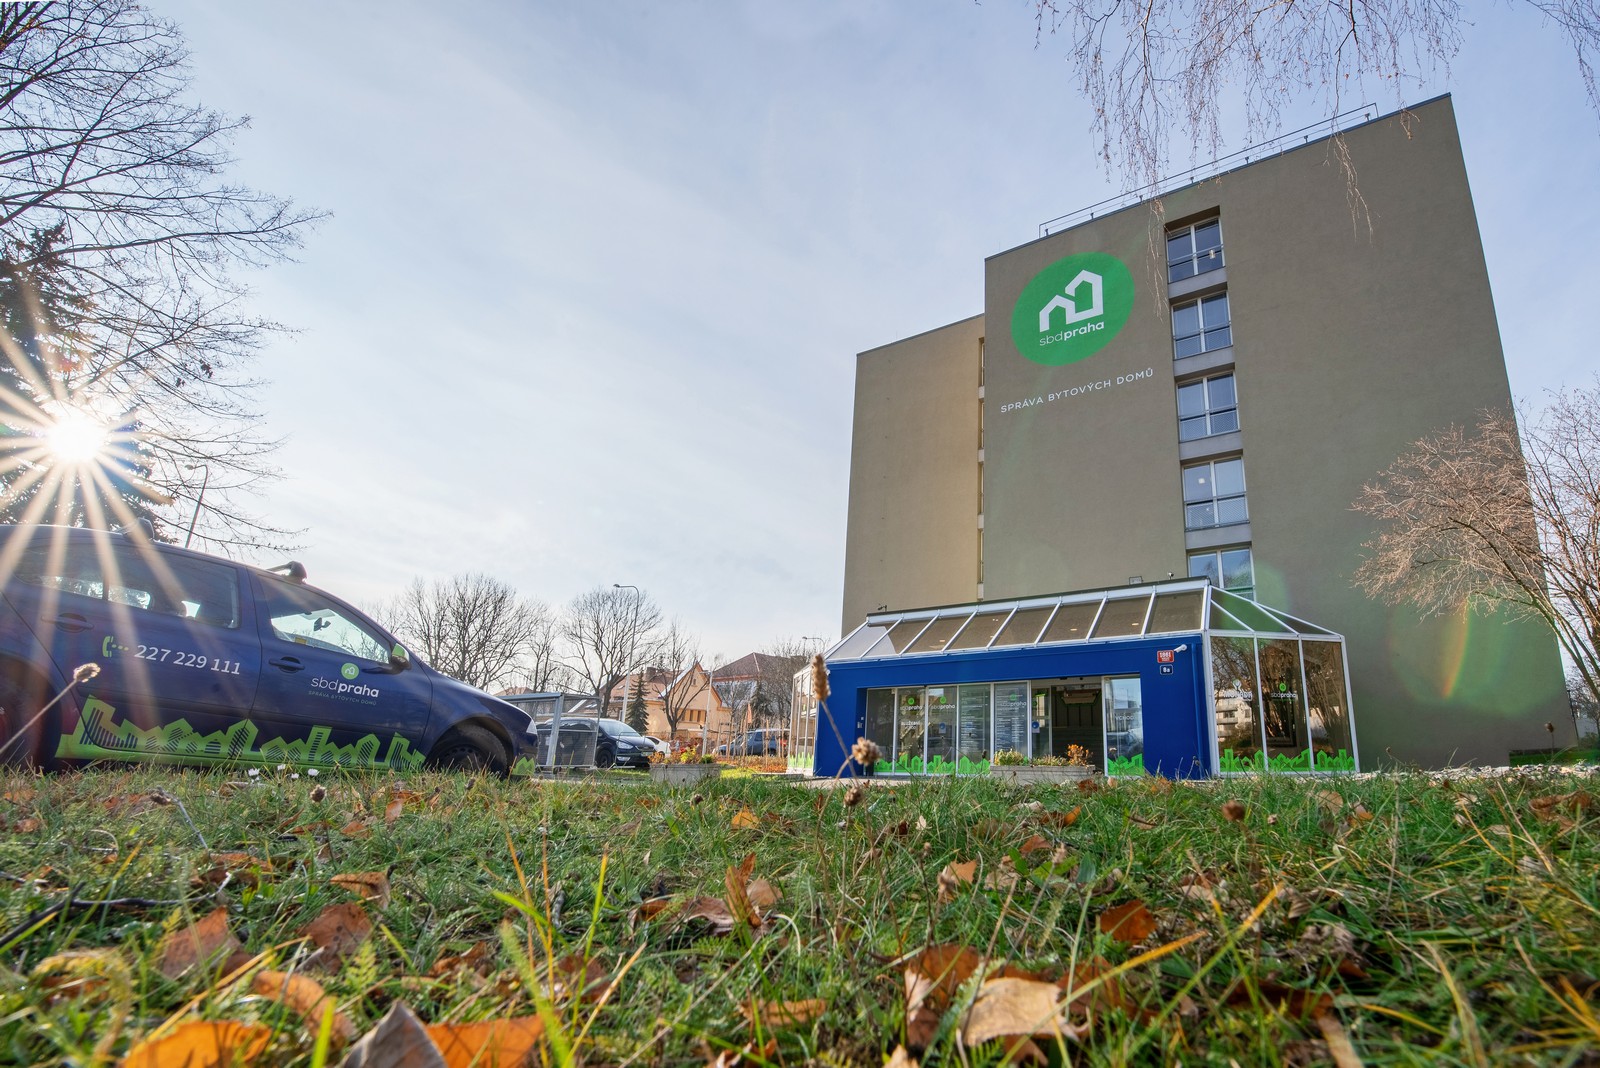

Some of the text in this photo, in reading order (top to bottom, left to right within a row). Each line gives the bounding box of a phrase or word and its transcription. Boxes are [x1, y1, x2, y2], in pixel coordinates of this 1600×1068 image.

[1039, 321, 1105, 346] sbdpraha
[1000, 367, 1154, 413] SPRÁVA BYTOVÝCH DOMŮ
[134, 644, 240, 675] 227 229 111
[310, 676, 380, 698] sbdpraha
